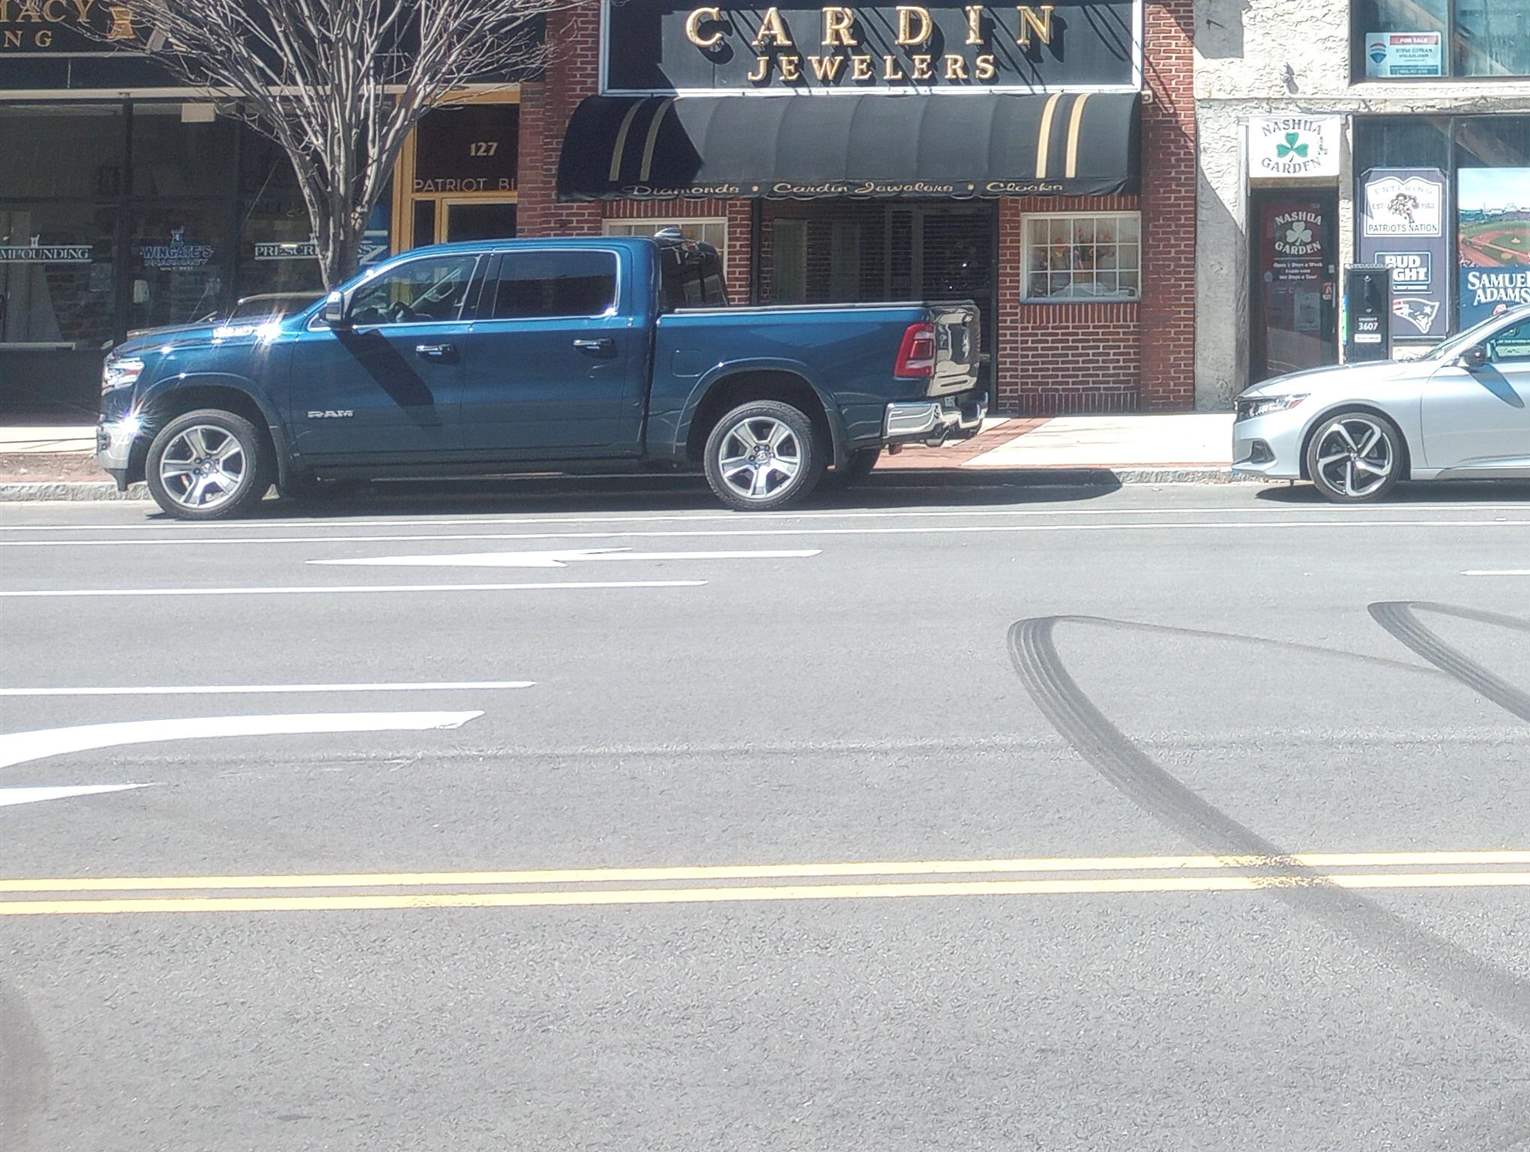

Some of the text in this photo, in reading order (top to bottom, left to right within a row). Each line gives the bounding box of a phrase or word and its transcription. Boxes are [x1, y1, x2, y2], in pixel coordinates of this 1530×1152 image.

[685, 5, 1054, 47] CARDIN
[748, 54, 995, 82] JEWELERS
[1262, 118, 1322, 137] NASHUA
[469, 141, 498, 157] 127
[1261, 156, 1322, 175] GARDEN
[414, 178, 488, 192] PATRIOT
[622, 184, 740, 196] Diamonds
[772, 183, 848, 194] Cardin
[853, 181, 954, 194] Jewelers
[1275, 211, 1322, 225] NASHUA
[1368, 223, 1438, 232] PATRIOTS NATION
[1274, 241, 1322, 255] GARDEN
[1385, 255, 1421, 268] BUD
[1393, 268, 1427, 281] GHT
[1357, 322, 1379, 331] 3607
[307, 410, 353, 418] RAM
